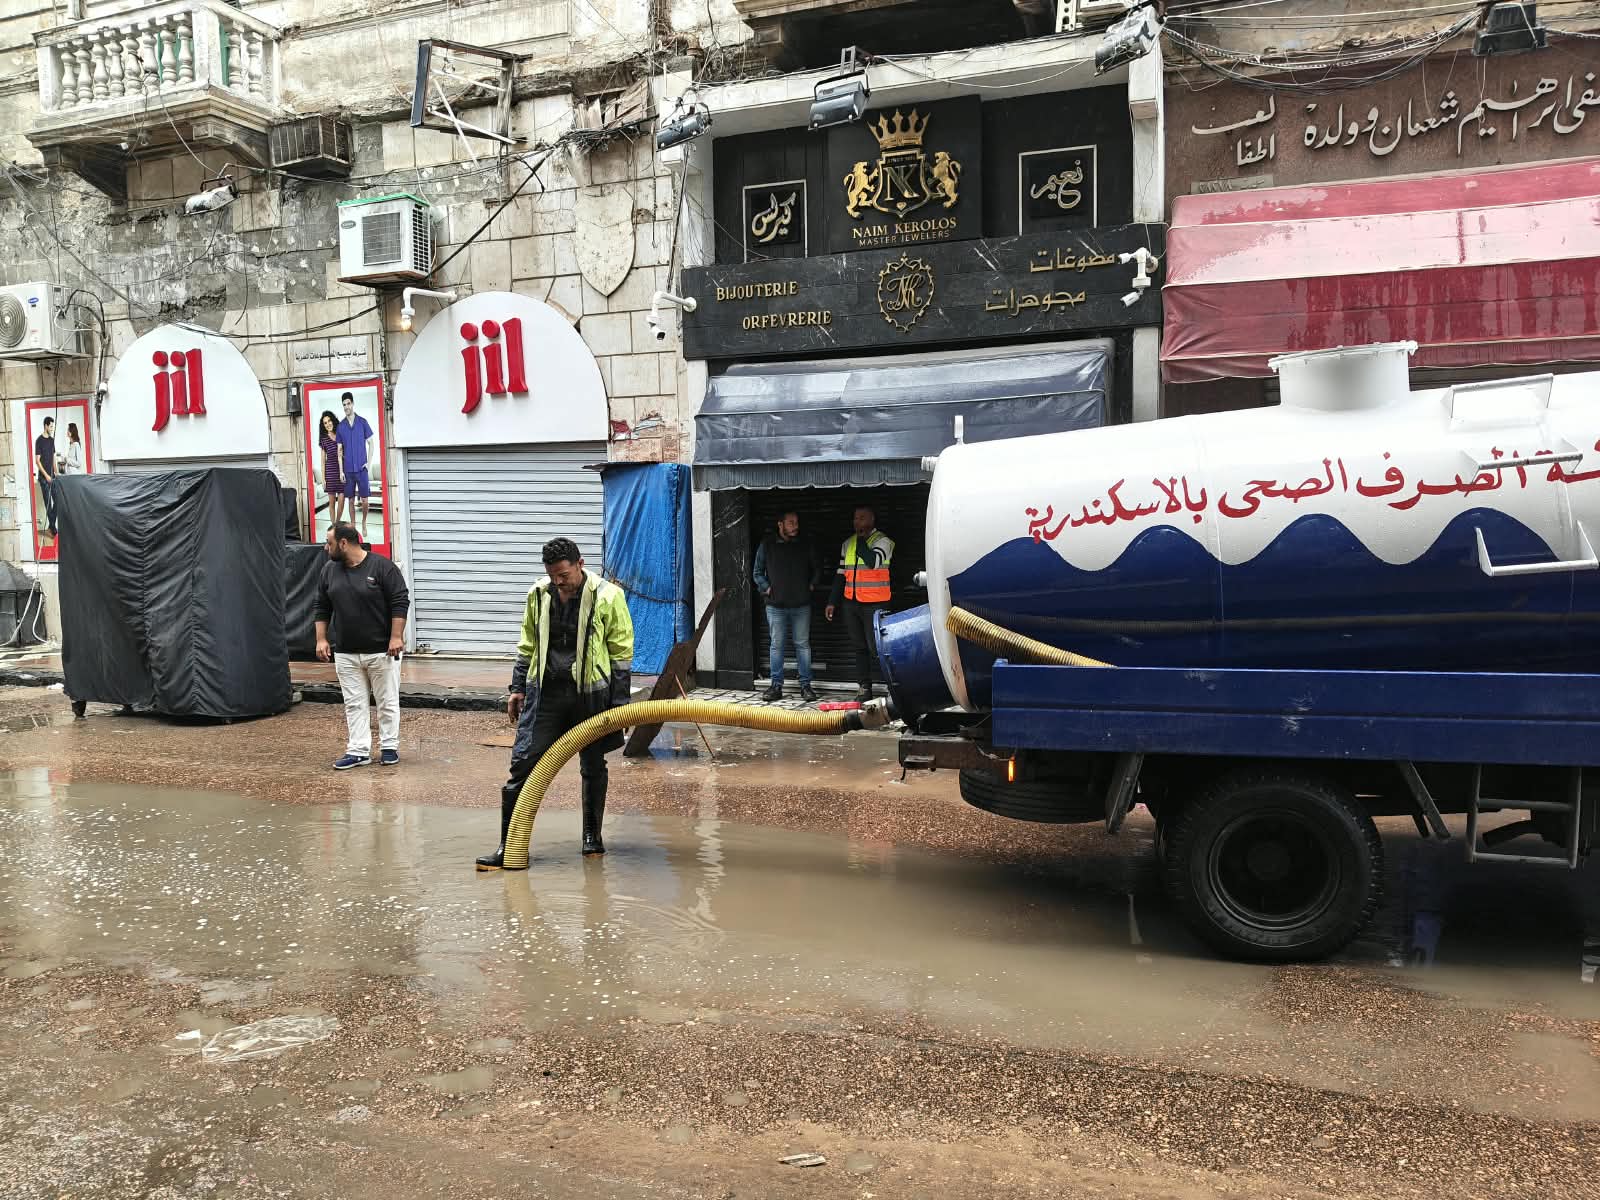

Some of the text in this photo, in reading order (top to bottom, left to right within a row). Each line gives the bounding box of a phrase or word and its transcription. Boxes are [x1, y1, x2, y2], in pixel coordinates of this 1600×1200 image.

[852, 216, 957, 239] NAIM KEROLOS
[859, 229, 951, 247] MASTER JEWELERS
[1029, 247, 1116, 273] مصوغات
[716, 280, 798, 301] BIJOUTERIE
[985, 287, 1087, 319] مجوهرات
[742, 310, 832, 331] ORFEVRERIE
[460, 317, 529, 414] jil
[152, 348, 207, 432] jil
[1355, 446, 1528, 511] الصرف
[1025, 475, 1208, 544] بالاسكندرية
